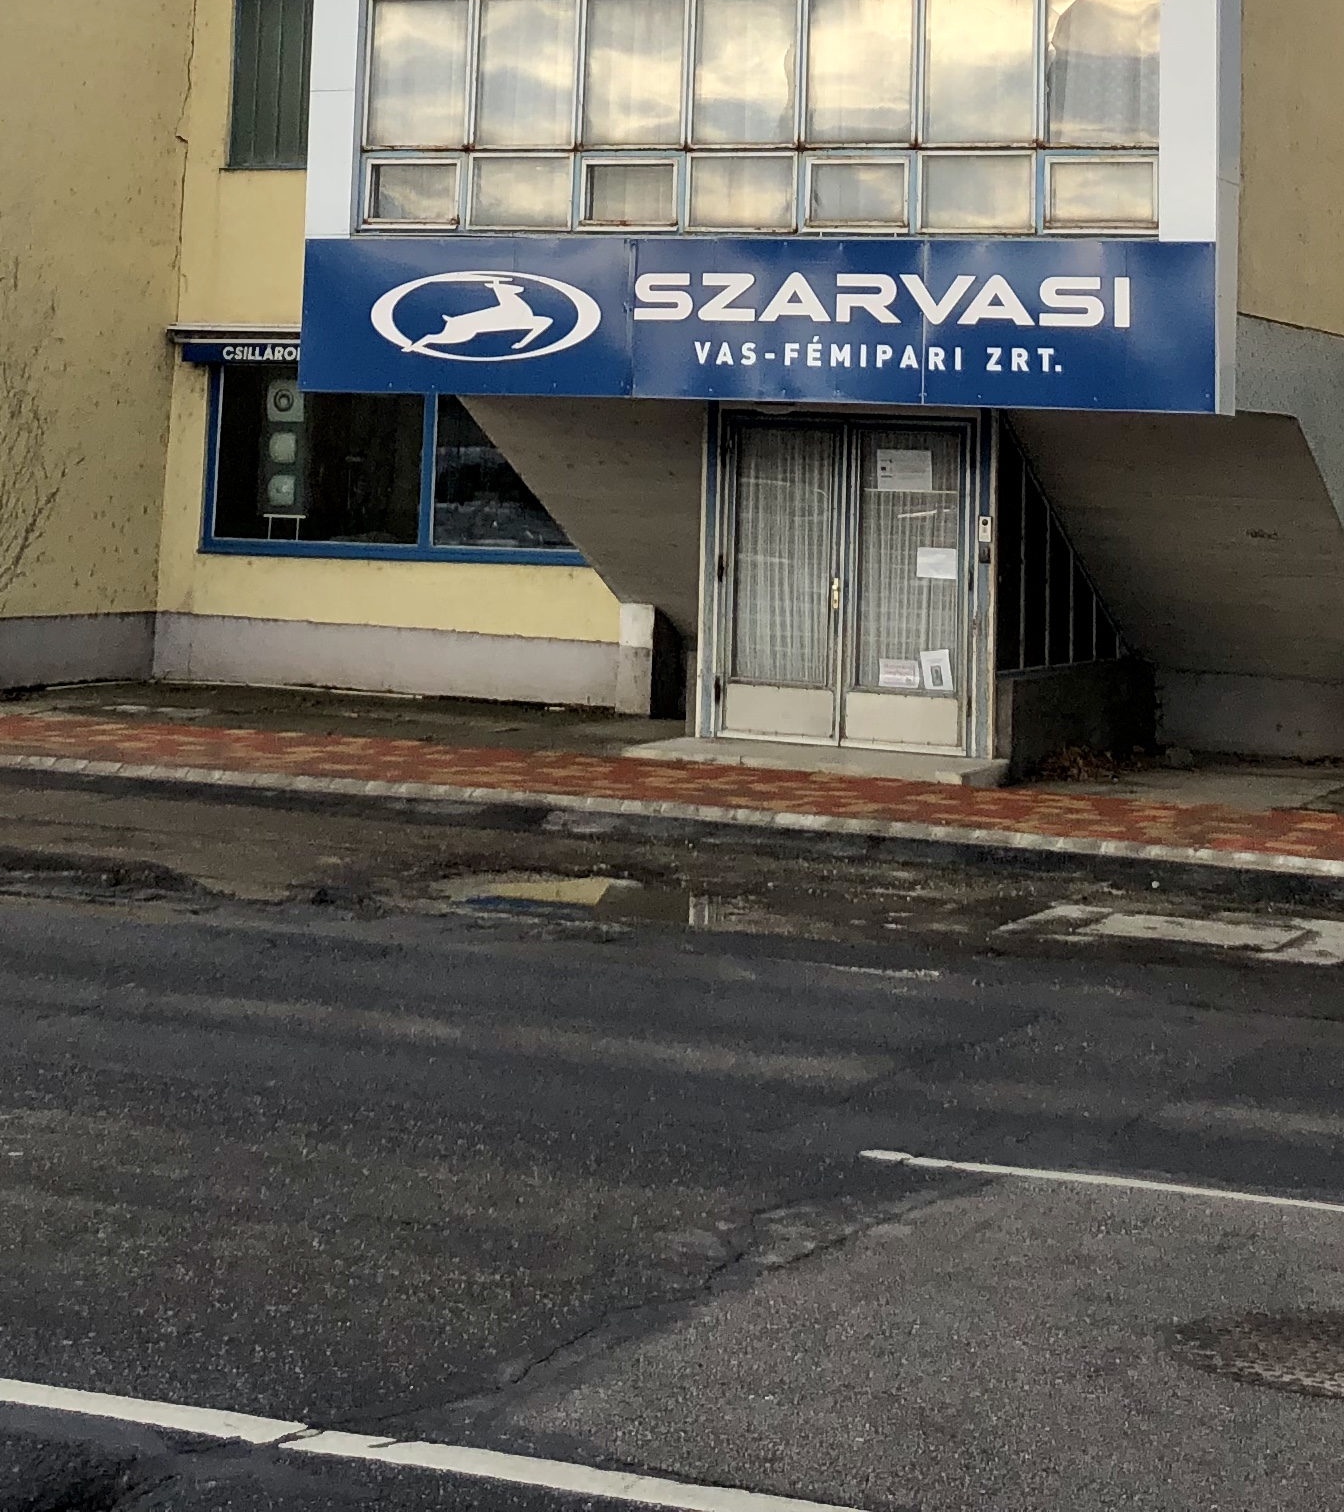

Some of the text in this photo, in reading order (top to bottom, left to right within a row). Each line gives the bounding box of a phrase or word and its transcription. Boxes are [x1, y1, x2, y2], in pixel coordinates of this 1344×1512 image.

[633, 271, 1132, 329] SZARVASI
[222, 344, 301, 361] CSILLÁRO
[693, 335, 1064, 373] VAS-FÉMIPARI ZRT.
